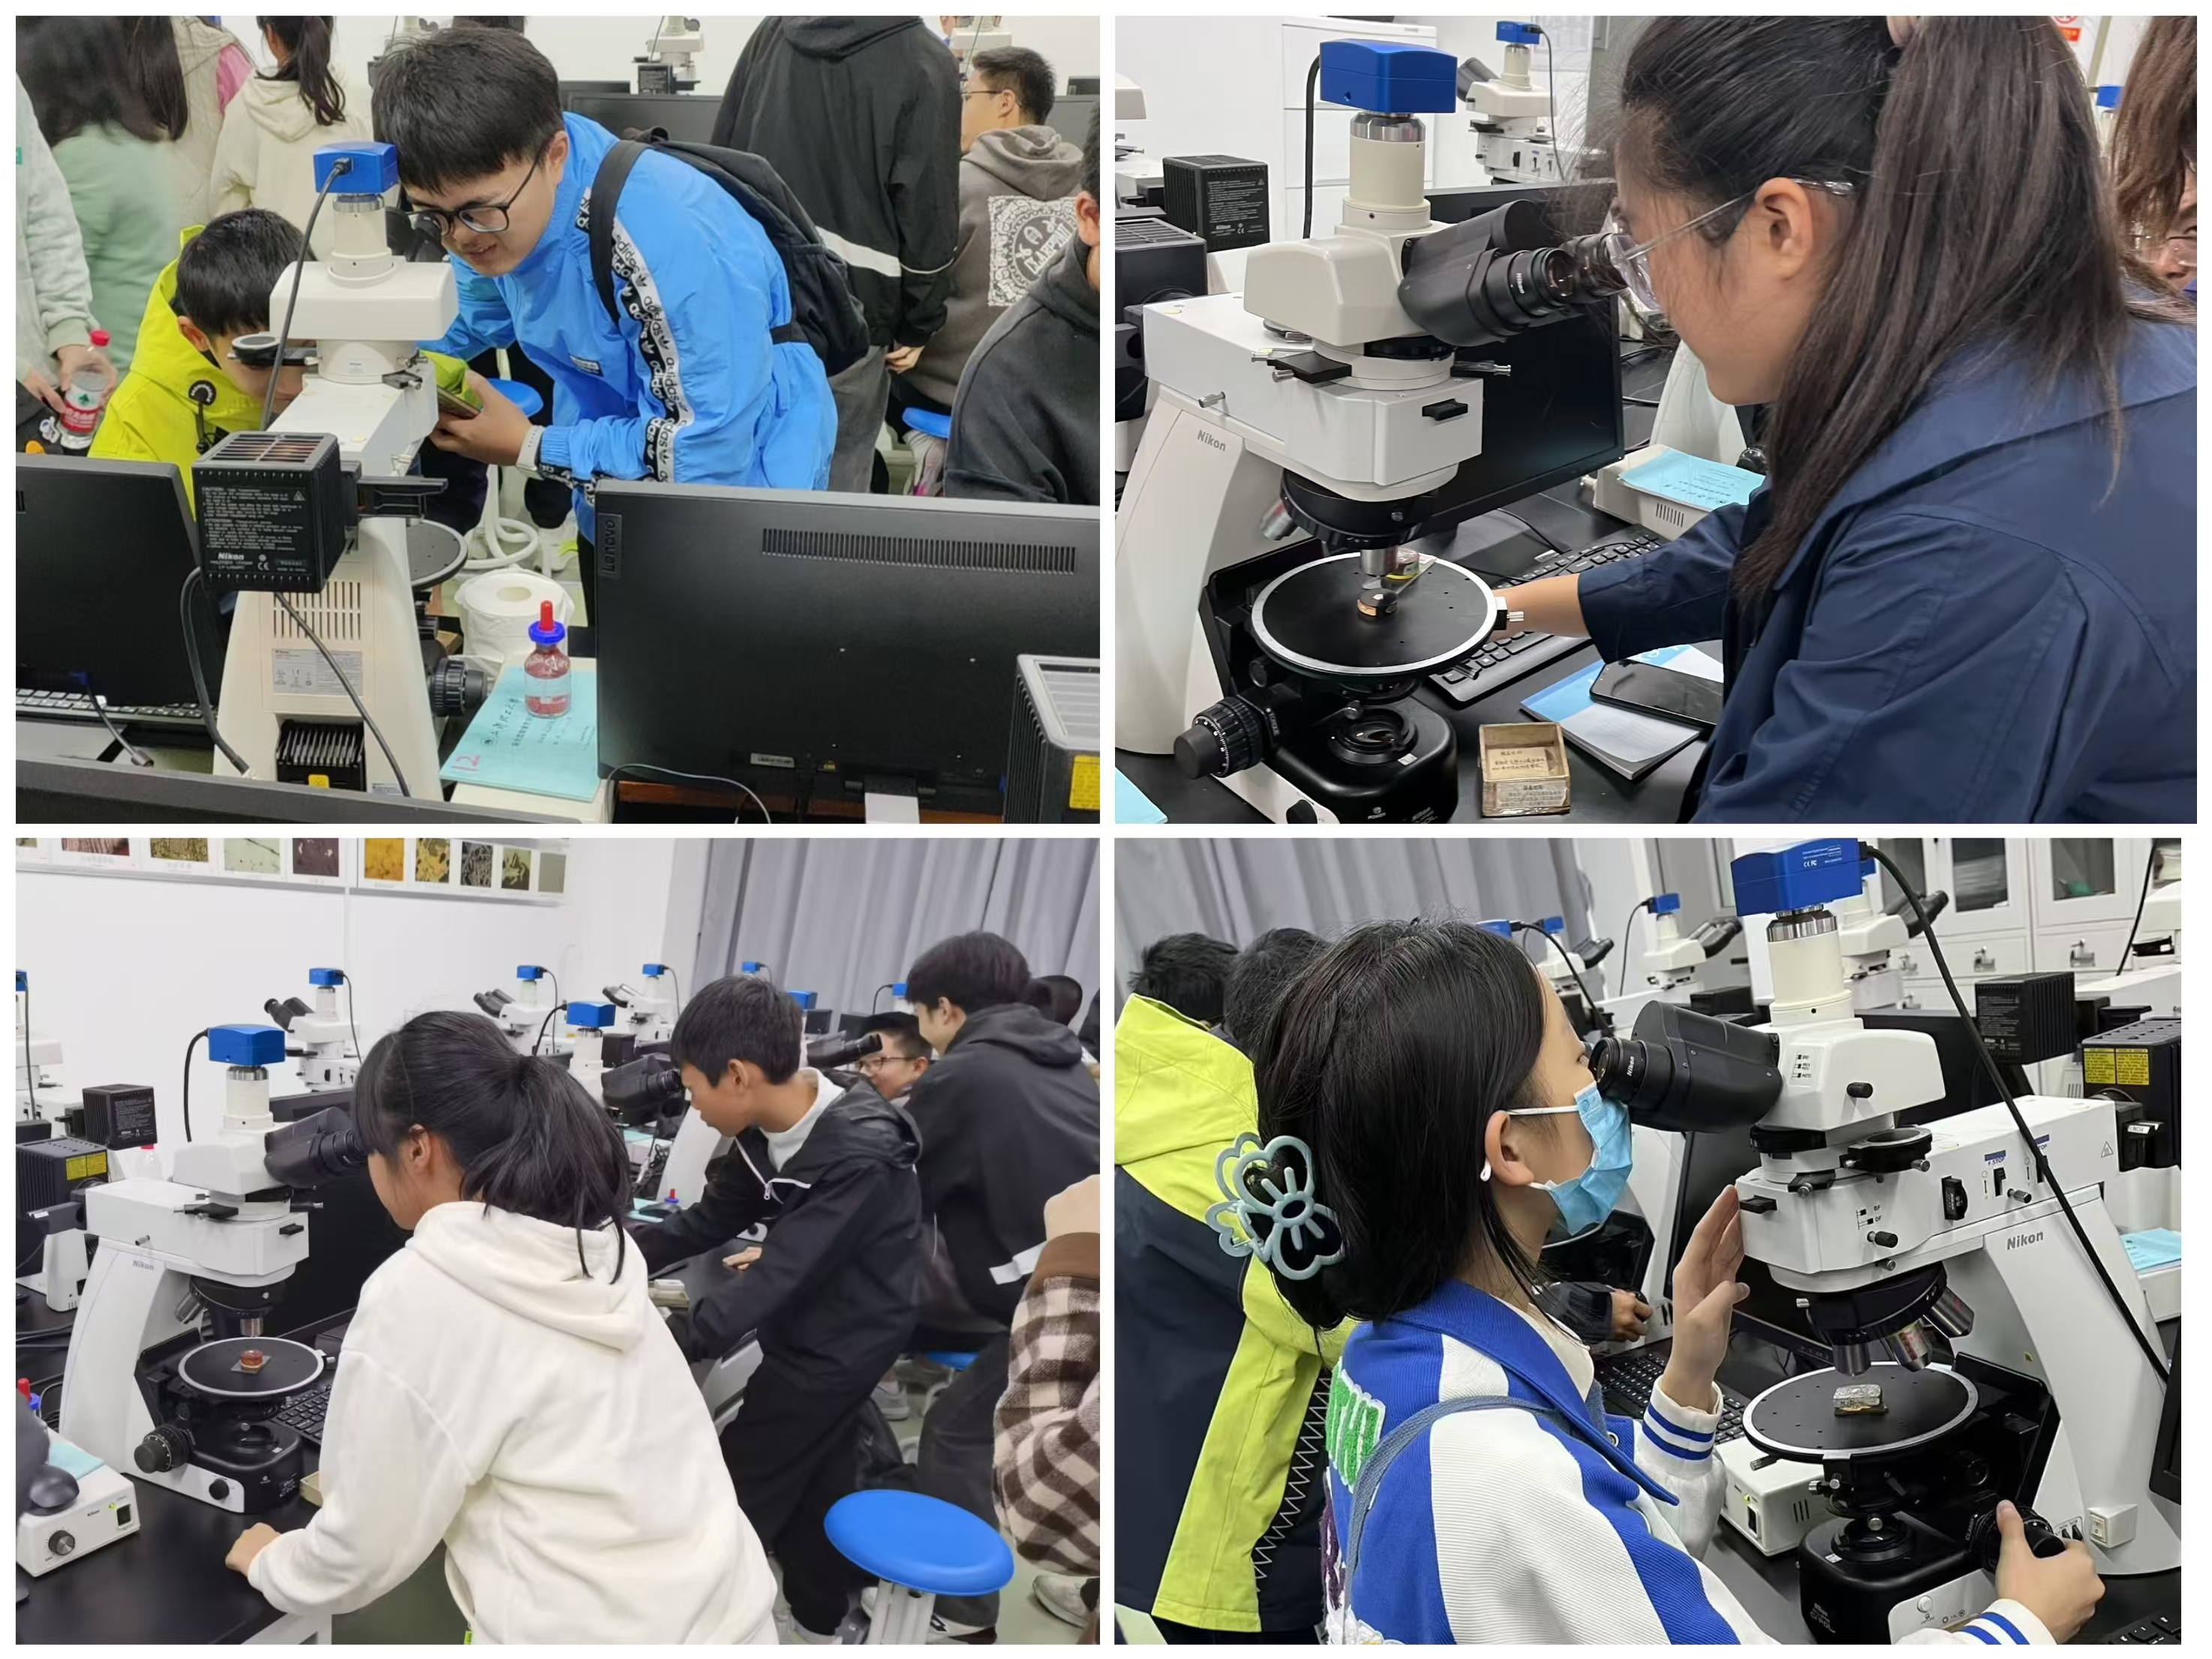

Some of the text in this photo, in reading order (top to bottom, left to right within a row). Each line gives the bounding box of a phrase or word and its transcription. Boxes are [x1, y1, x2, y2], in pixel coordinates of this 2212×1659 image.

[1197, 429, 1226, 452] Nikon
[602, 519, 615, 572] Lenovo
[217, 552, 245, 561] Nikon
[1626, 1056, 1634, 1077] Nikon
[2006, 1231, 2044, 1251] Nikon
[132, 1260, 155, 1271] Nikon
